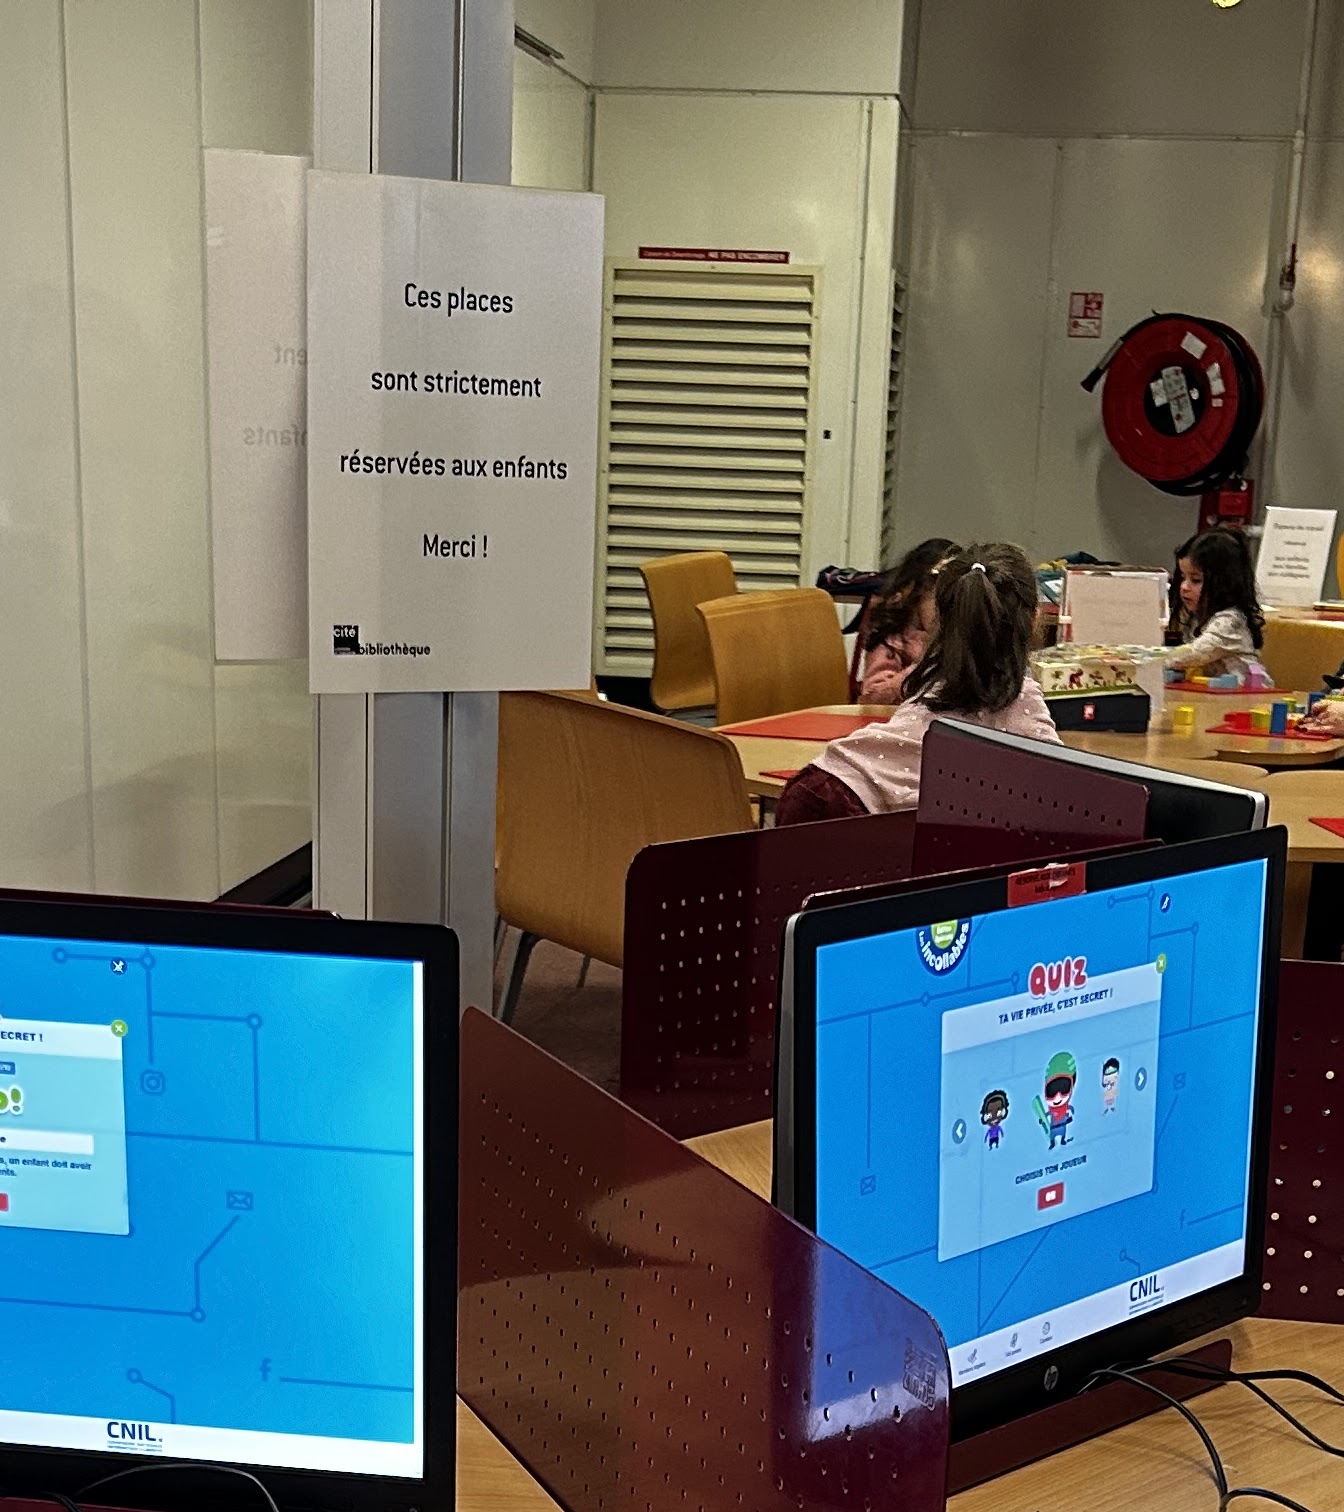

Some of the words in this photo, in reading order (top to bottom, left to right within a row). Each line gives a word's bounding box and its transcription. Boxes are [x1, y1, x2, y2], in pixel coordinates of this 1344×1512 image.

[404, 283, 441, 310] Ces
[447, 286, 514, 317] places
[371, 370, 418, 393] sont
[424, 370, 541, 398] strictement
[340, 449, 445, 477] réservées
[451, 458, 488, 478] aux
[492, 453, 568, 480] enfants
[423, 534, 476, 559] Merci
[334, 626, 356, 638] cité
[358, 643, 431, 658] bibliothèque
[921, 923, 969, 971] incollables
[1029, 958, 1087, 997] QUIZ
[999, 1014, 1009, 1024] TA
[1011, 1009, 1024, 1021] VIE
[1080, 989, 1109, 1005] SECRET
[22, 1158, 49, 1167] enfant
